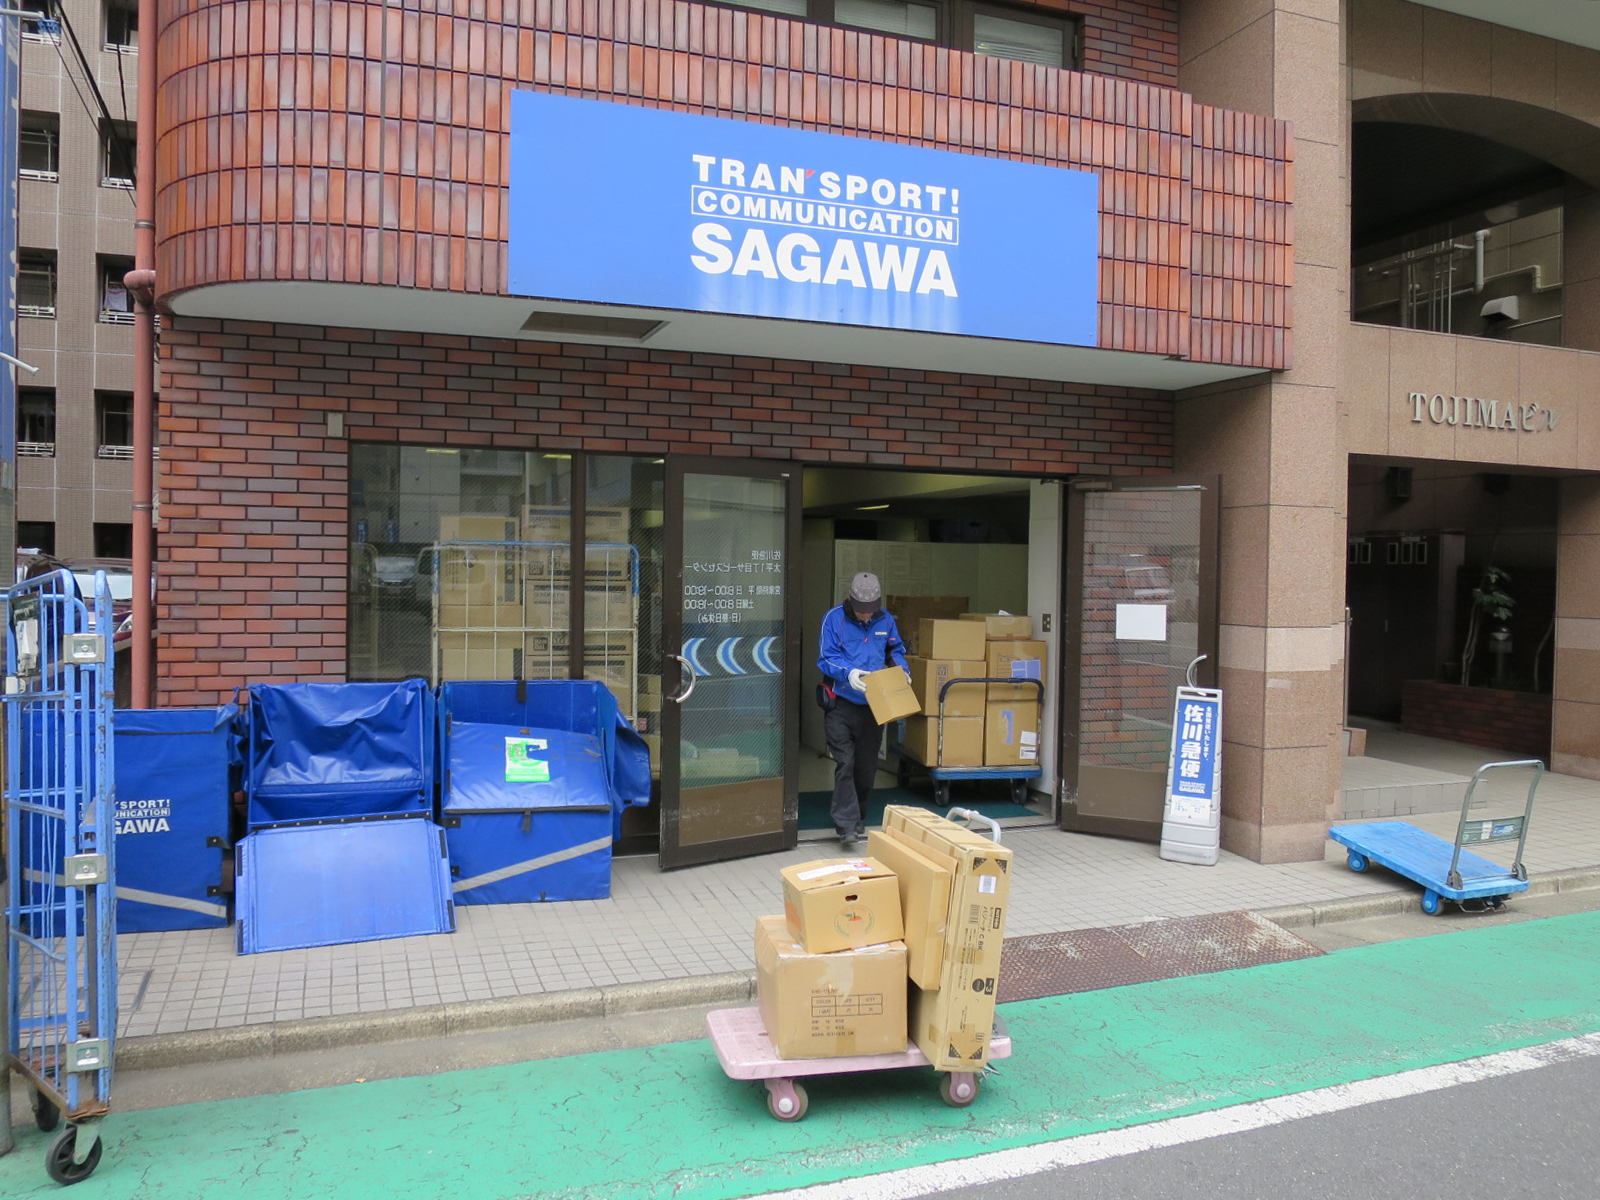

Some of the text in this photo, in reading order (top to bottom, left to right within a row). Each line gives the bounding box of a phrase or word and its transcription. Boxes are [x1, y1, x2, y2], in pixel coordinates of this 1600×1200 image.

[697, 190, 954, 240] COMMUNICATION
[691, 222, 958, 297] SAGAWA
[1180, 704, 1204, 778] 佐川急便
[115, 818, 170, 834] GAWA
